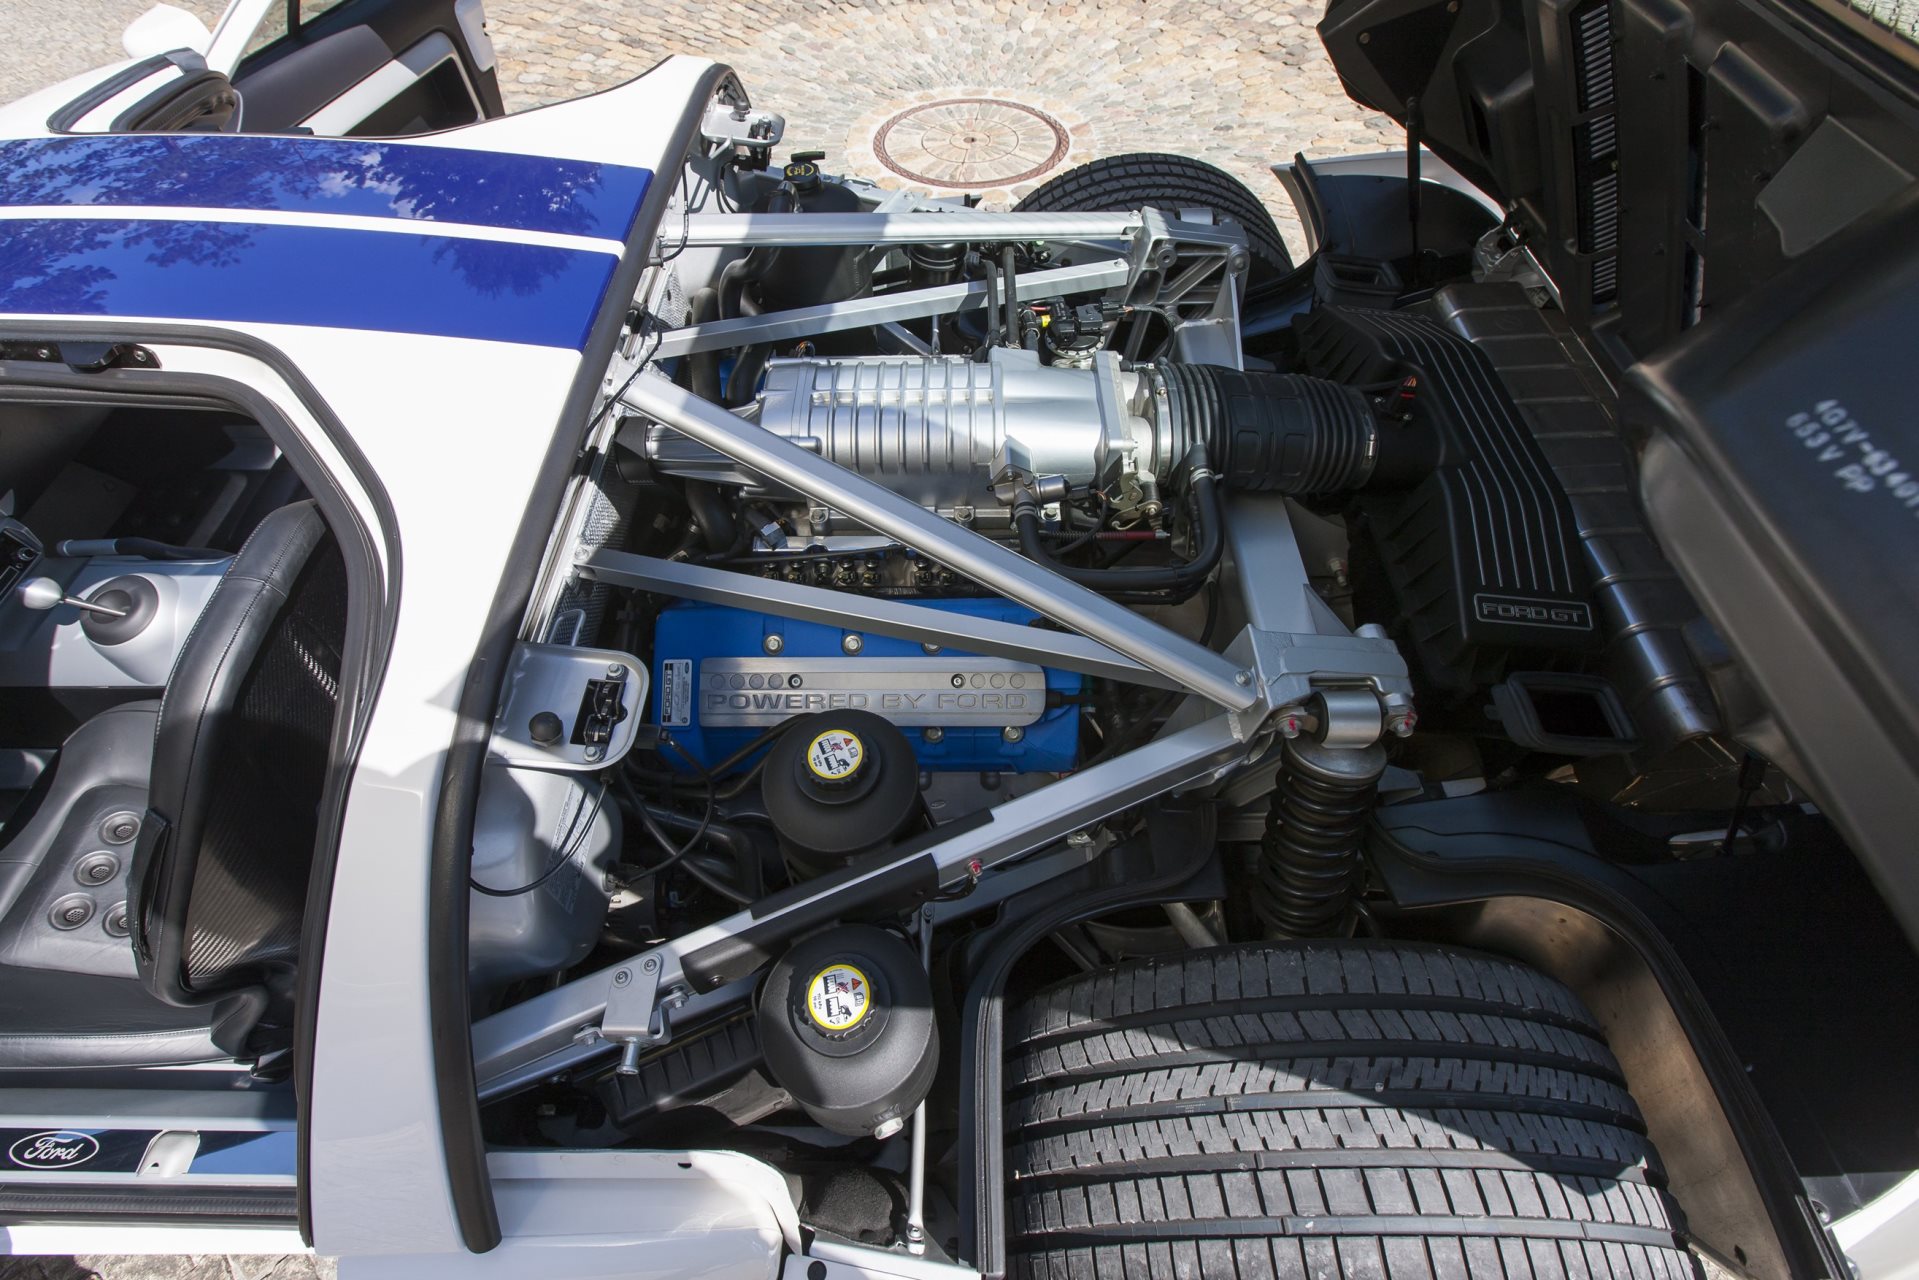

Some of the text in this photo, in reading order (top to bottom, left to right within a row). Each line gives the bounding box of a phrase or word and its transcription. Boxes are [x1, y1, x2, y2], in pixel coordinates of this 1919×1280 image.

[1482, 602, 1583, 623] FORD GT
[707, 693, 1028, 710] POWERED BY FORD
[23, 1136, 85, 1160] Ford
